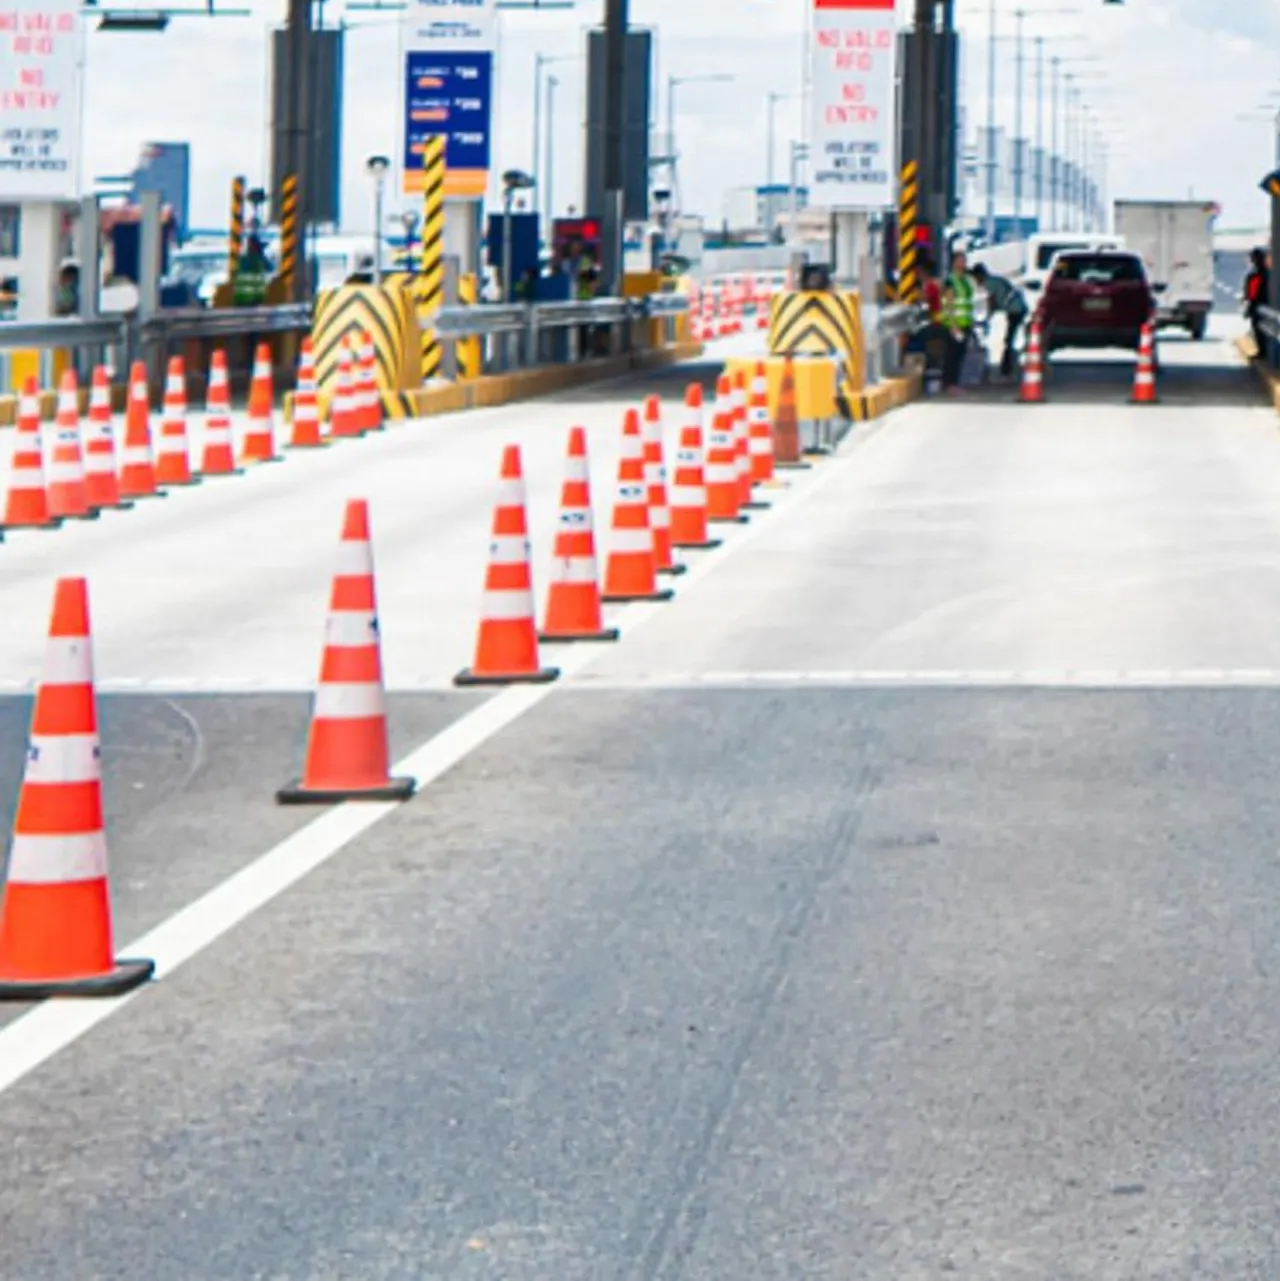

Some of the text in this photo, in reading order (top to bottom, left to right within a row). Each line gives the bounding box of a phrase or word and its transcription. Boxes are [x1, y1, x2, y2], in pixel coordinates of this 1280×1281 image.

[816, 30, 840, 48] NO
[836, 52, 873, 71] RFID
[842, 83, 865, 103] NO
[825, 105, 879, 123] ENTRY
